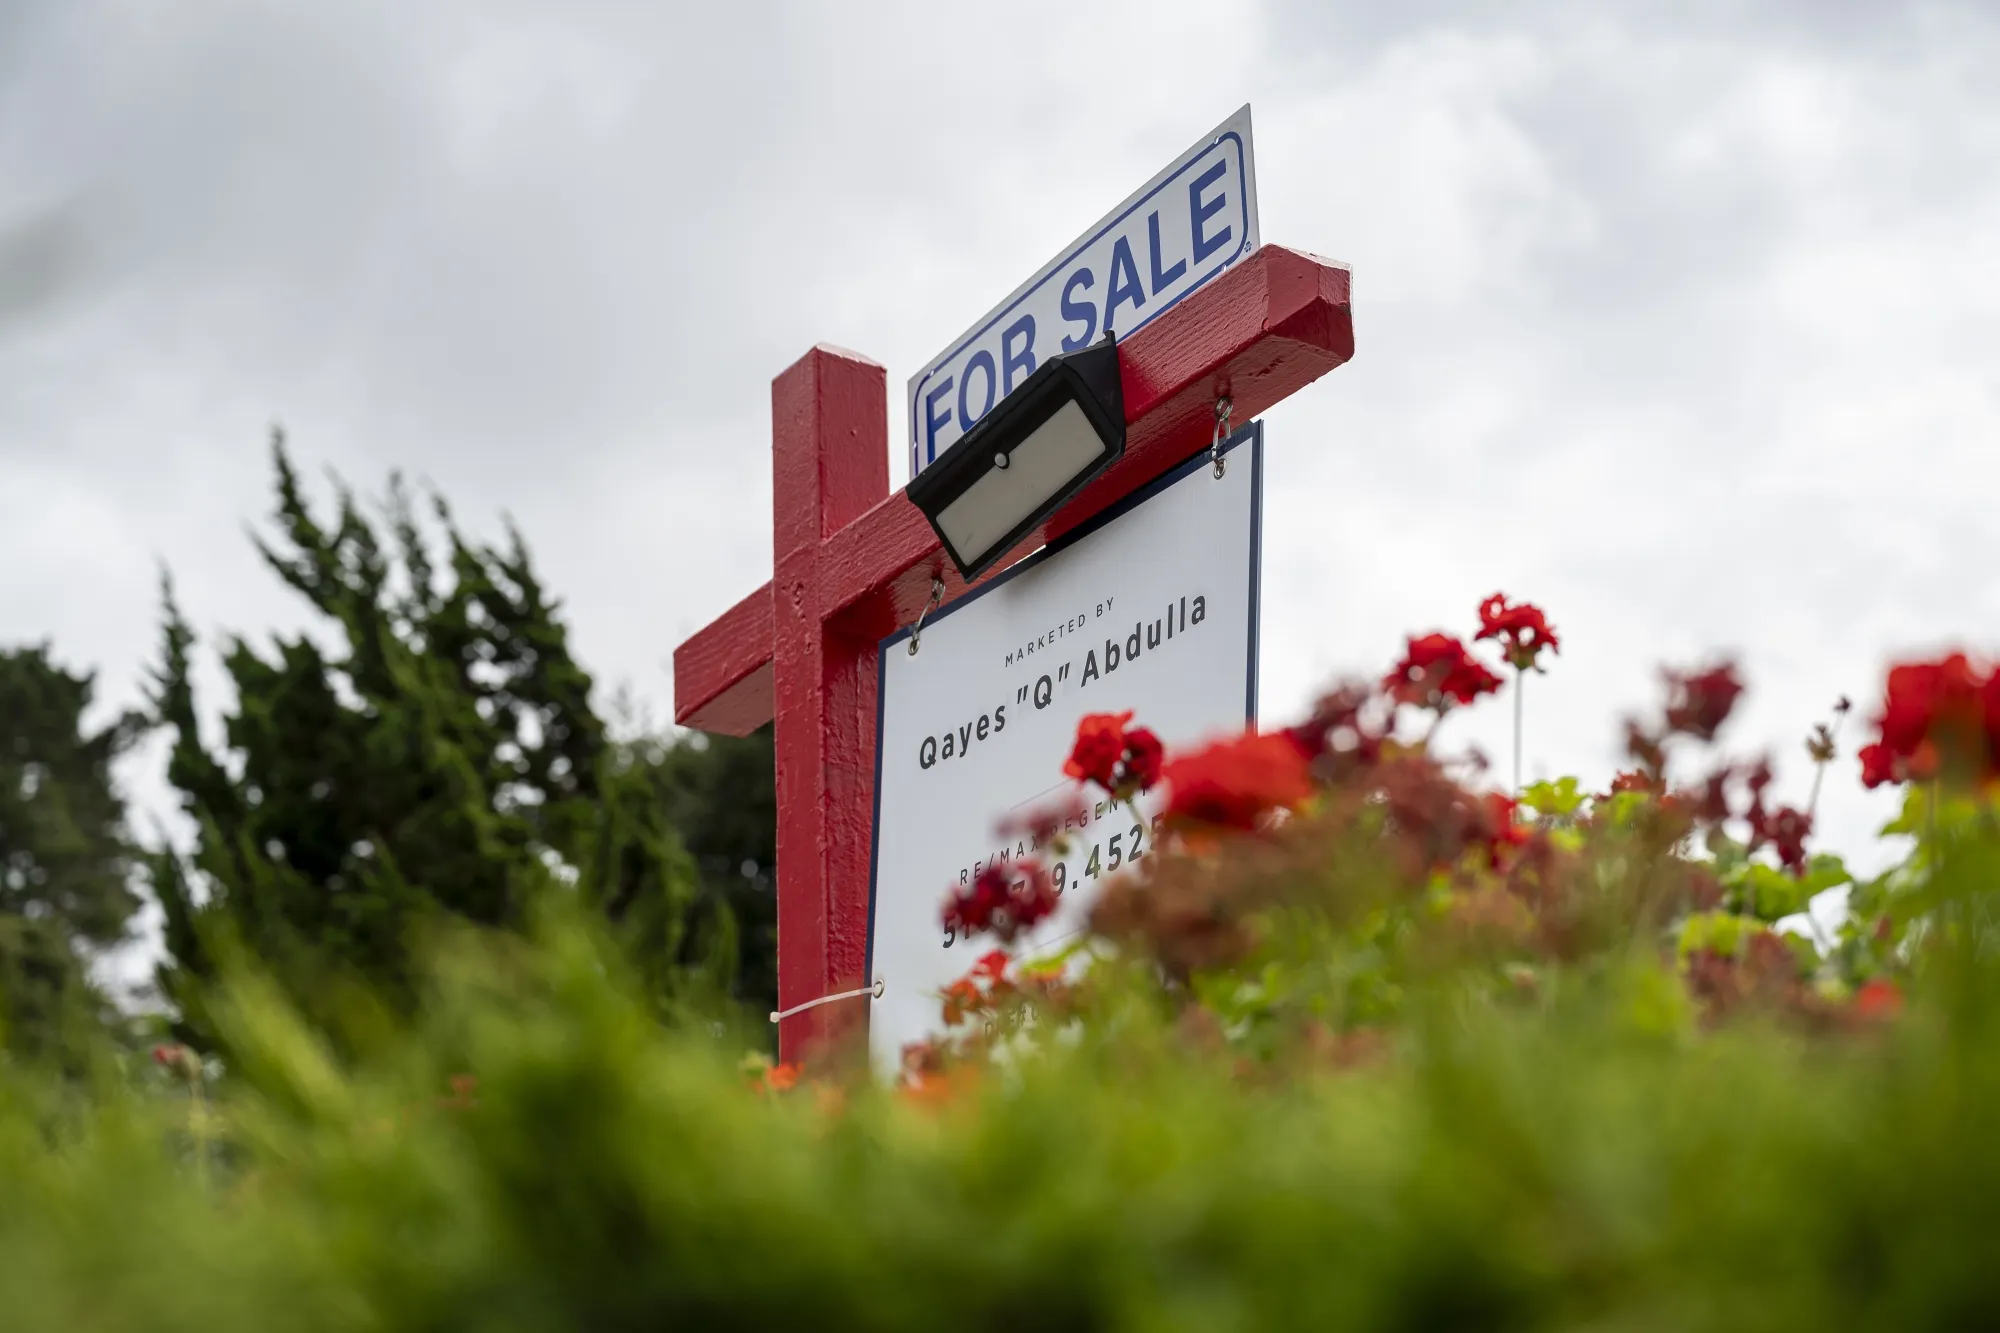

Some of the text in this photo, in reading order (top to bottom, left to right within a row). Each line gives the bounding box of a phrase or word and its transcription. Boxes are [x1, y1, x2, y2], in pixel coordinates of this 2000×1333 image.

[927, 157, 1232, 464] FOR SALE
[918, 594, 1207, 770] Qayes "Q" Abdulla
[1004, 597, 1115, 668] MARKETED BY
[942, 812, 1166, 948] 5.9.452
[959, 786, 1148, 886] RE/MAX EGEN
